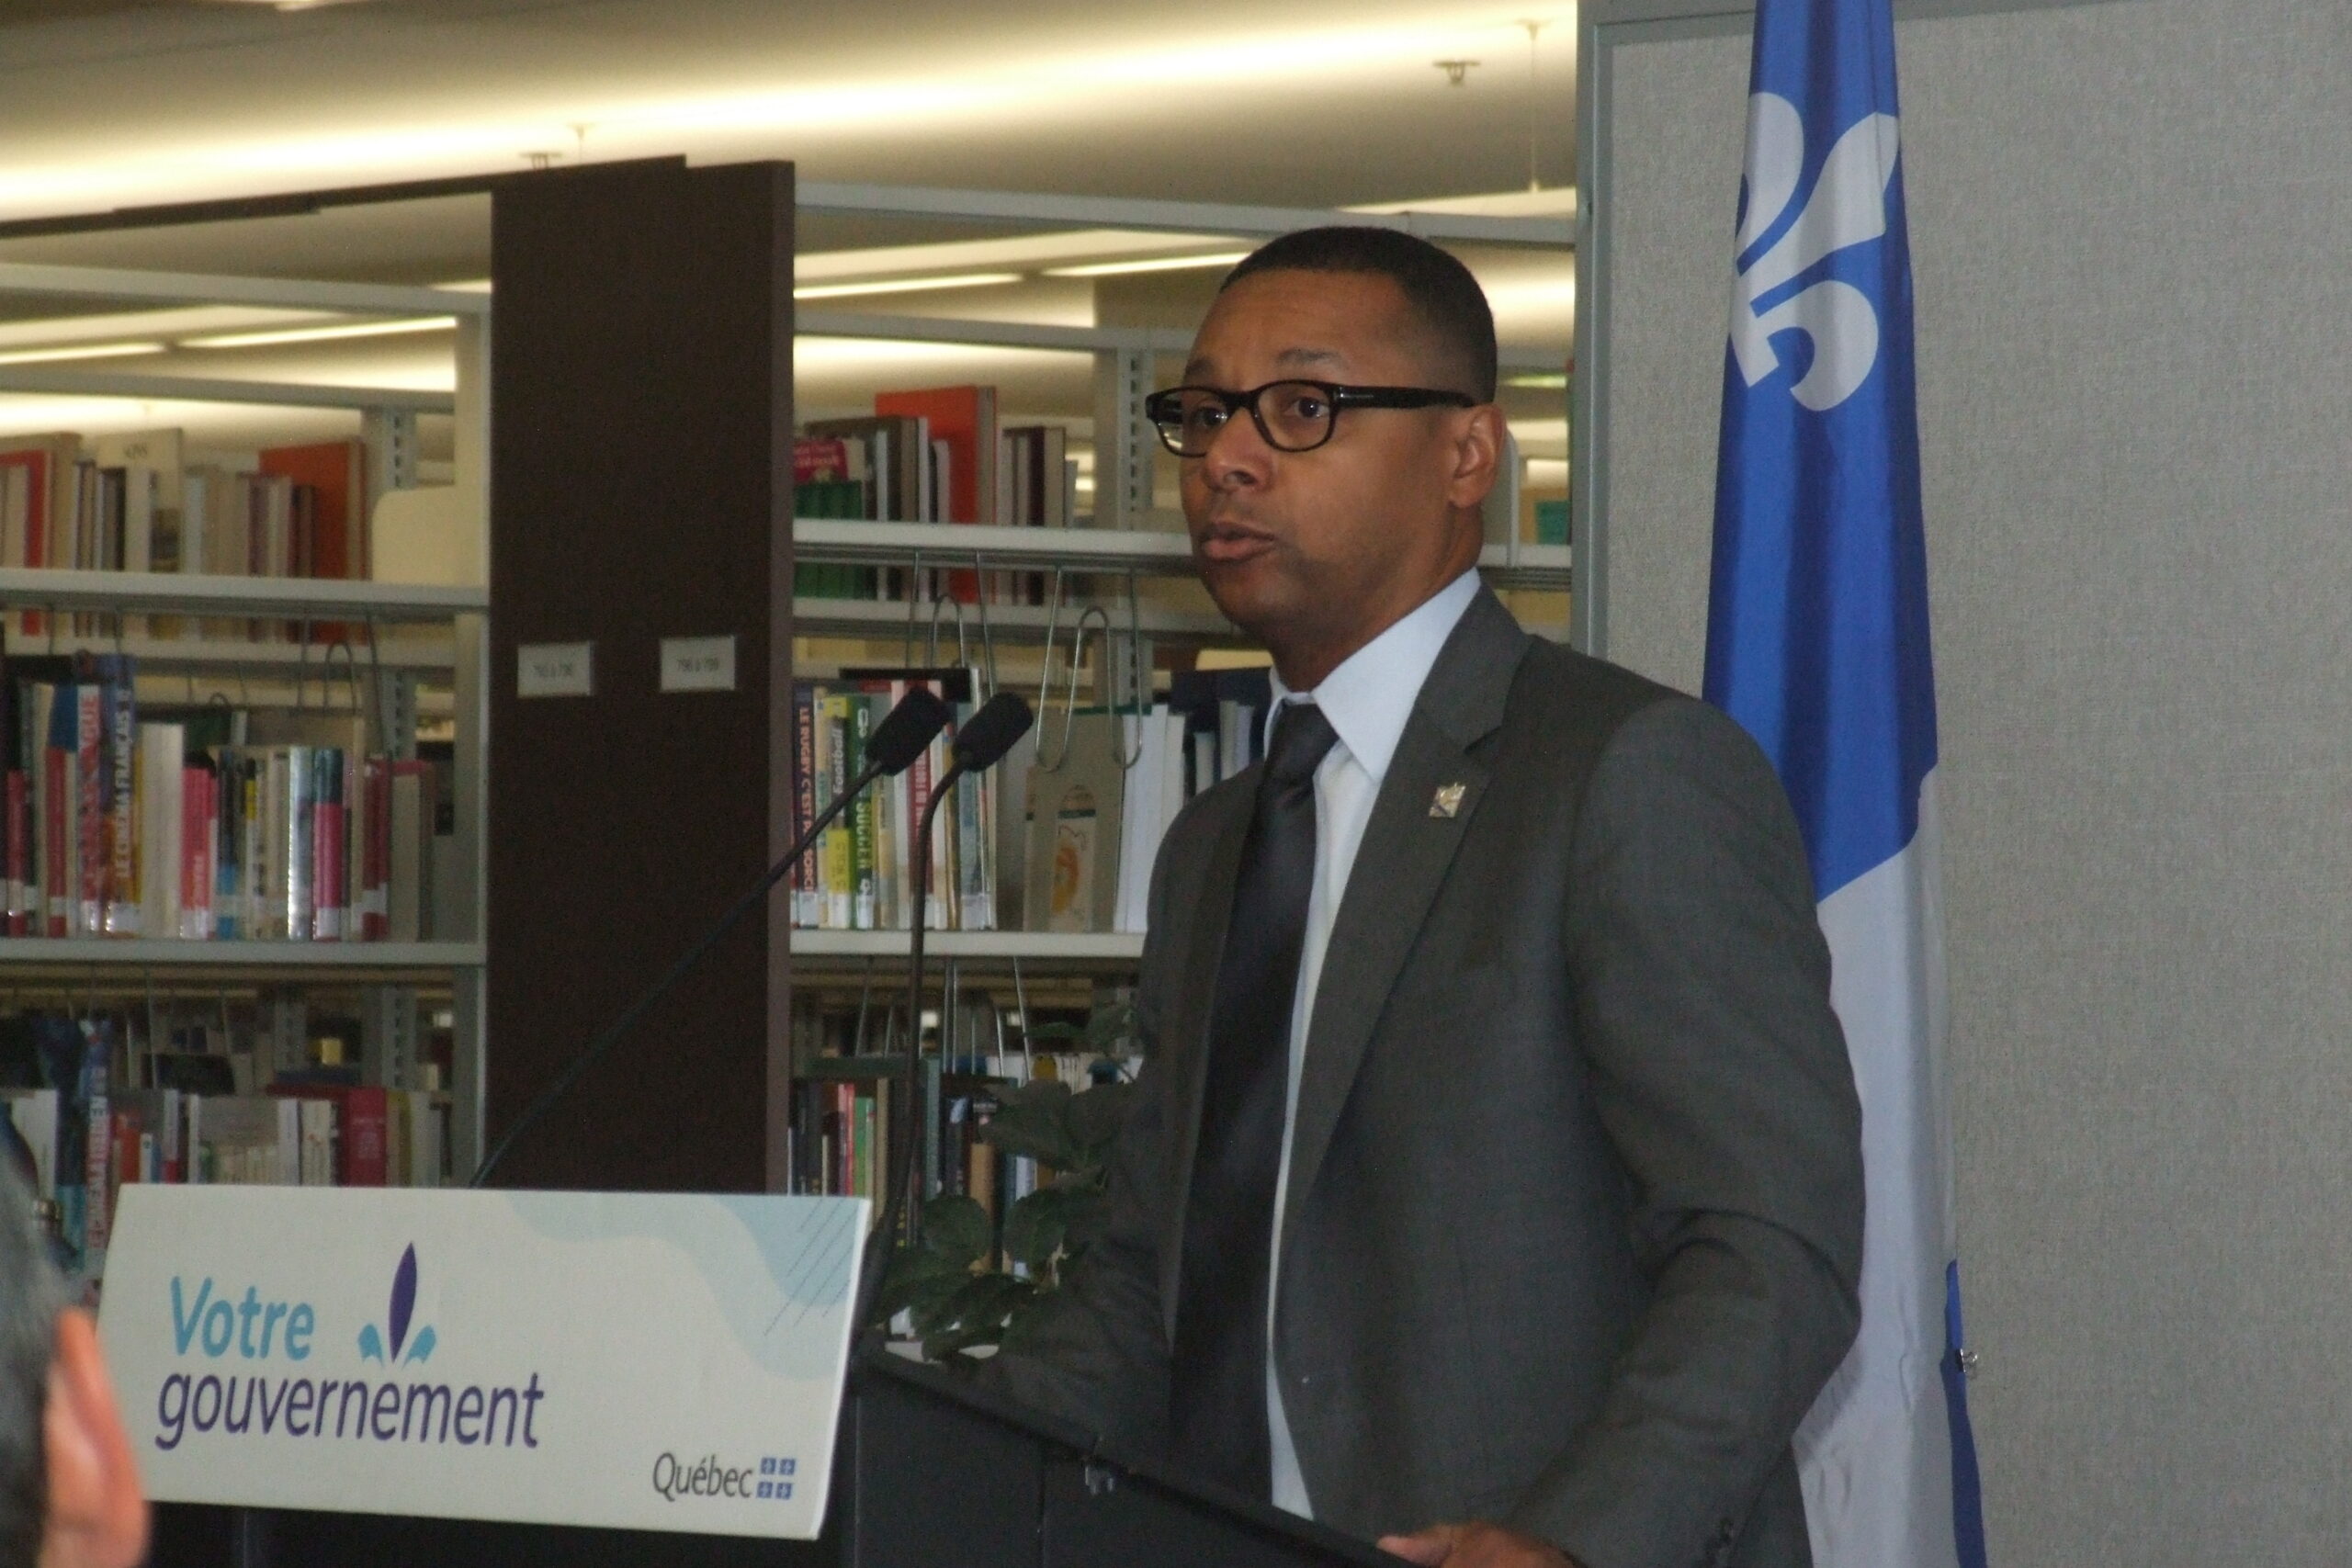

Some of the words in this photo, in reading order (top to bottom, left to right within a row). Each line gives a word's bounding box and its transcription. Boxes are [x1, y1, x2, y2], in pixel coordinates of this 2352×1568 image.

[799, 706, 810, 722] LE
[799, 726, 810, 773] RUGBY
[171, 1276, 315, 1360] Votre
[154, 1372, 545, 1450] gouvernement
[652, 1452, 754, 1503] Québec
